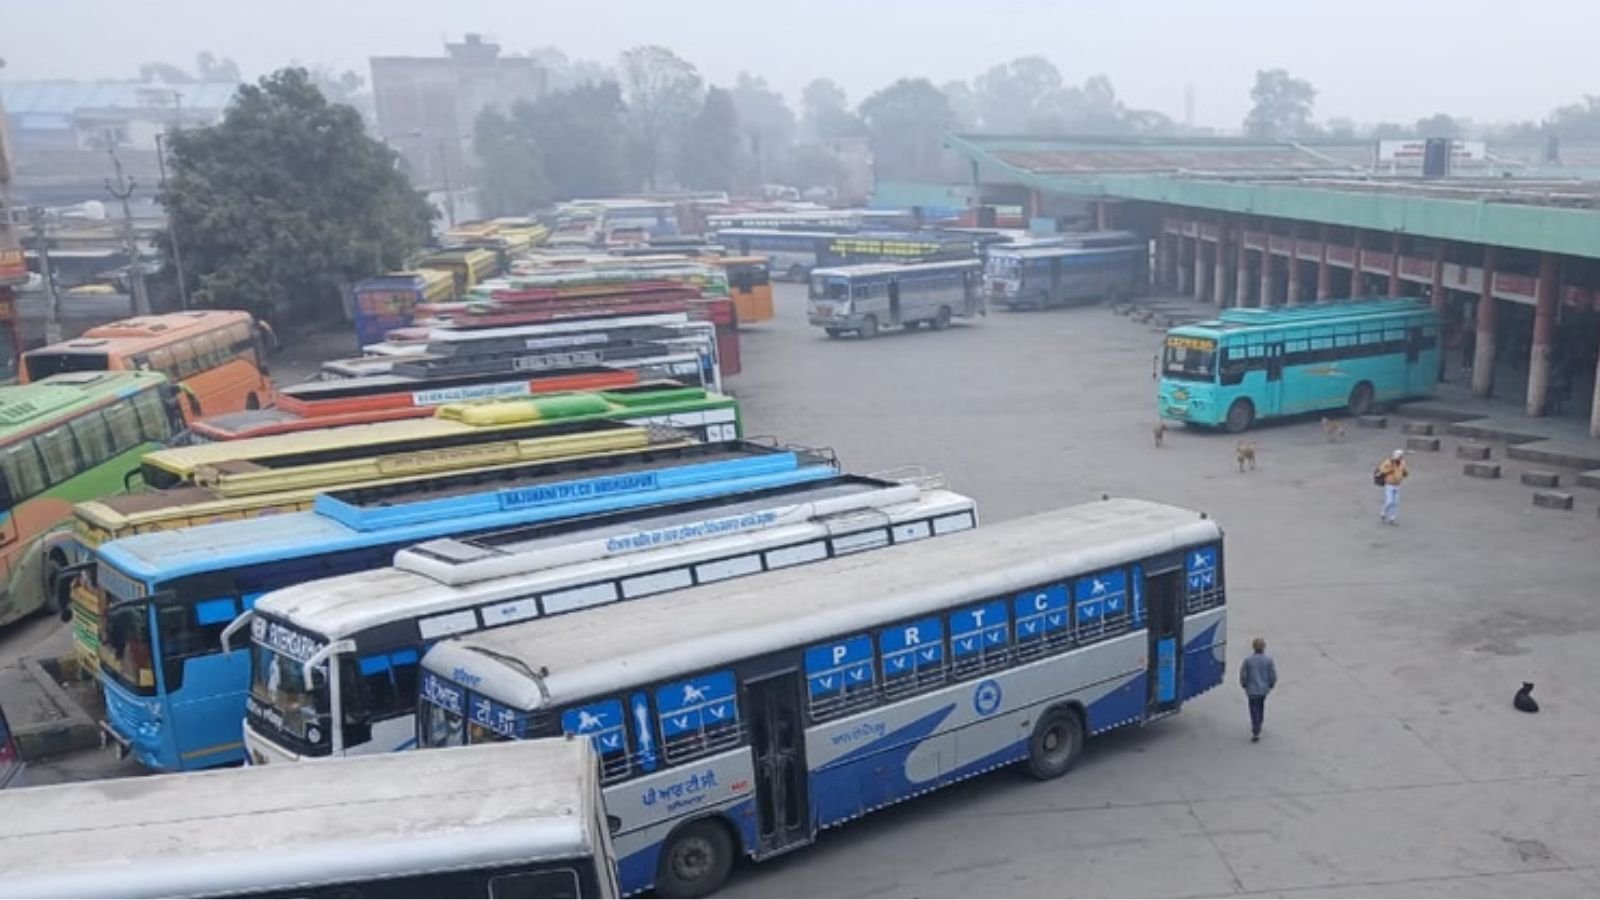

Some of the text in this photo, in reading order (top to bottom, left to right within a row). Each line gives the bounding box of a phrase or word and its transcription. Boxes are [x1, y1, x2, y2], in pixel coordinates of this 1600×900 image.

[833, 593, 1047, 665] P R T C
